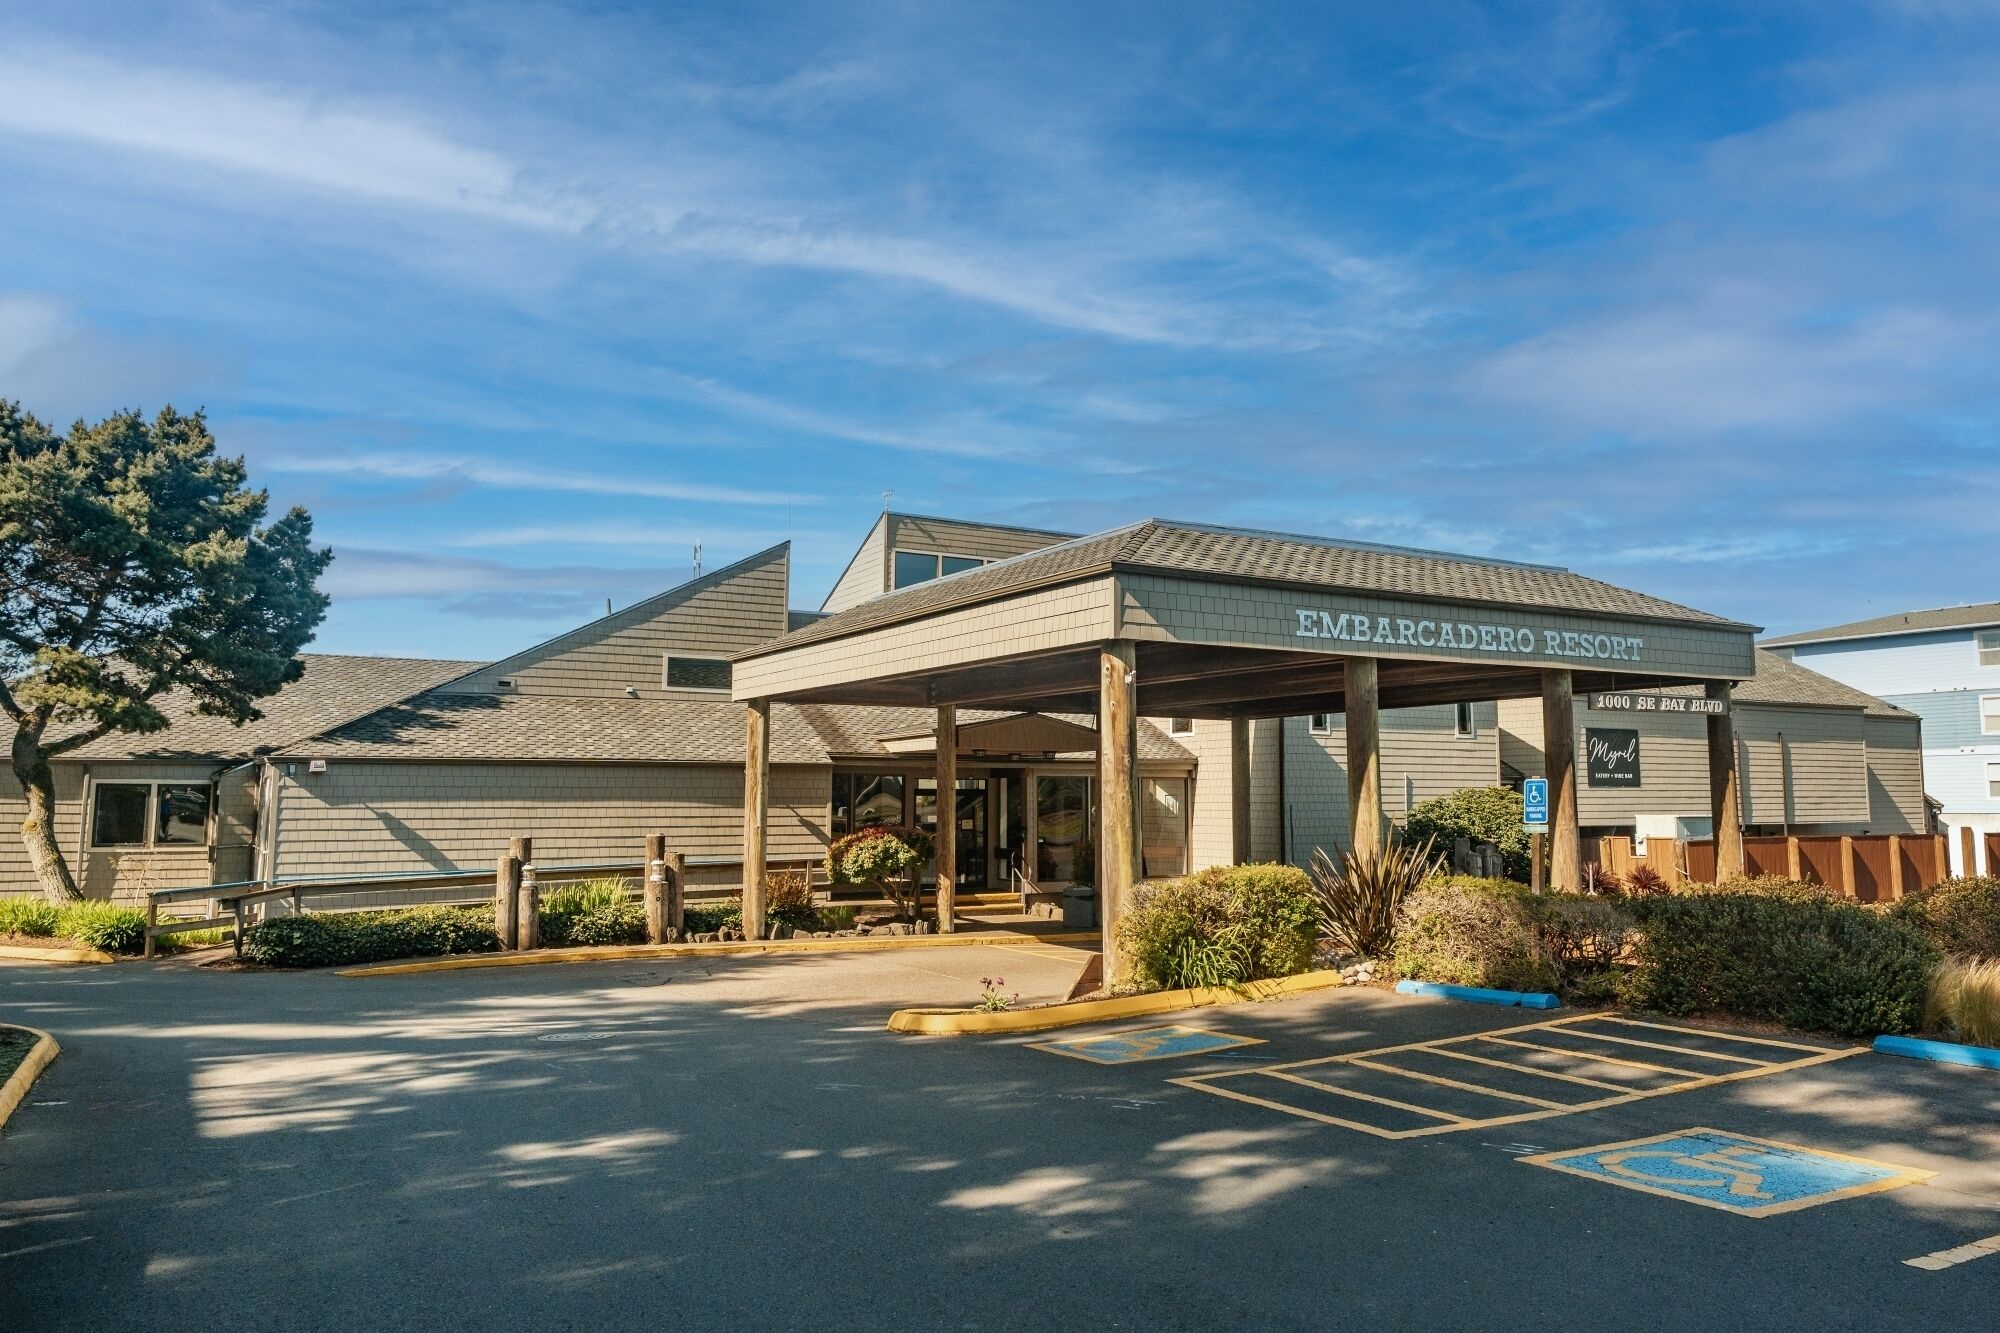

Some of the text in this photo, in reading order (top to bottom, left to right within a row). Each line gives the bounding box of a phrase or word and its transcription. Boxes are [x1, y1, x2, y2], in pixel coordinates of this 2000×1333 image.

[1295, 609, 1643, 661] EMBARCADERO RESORT
[1598, 695, 1723, 713] 1000 SE BAY BLVD
